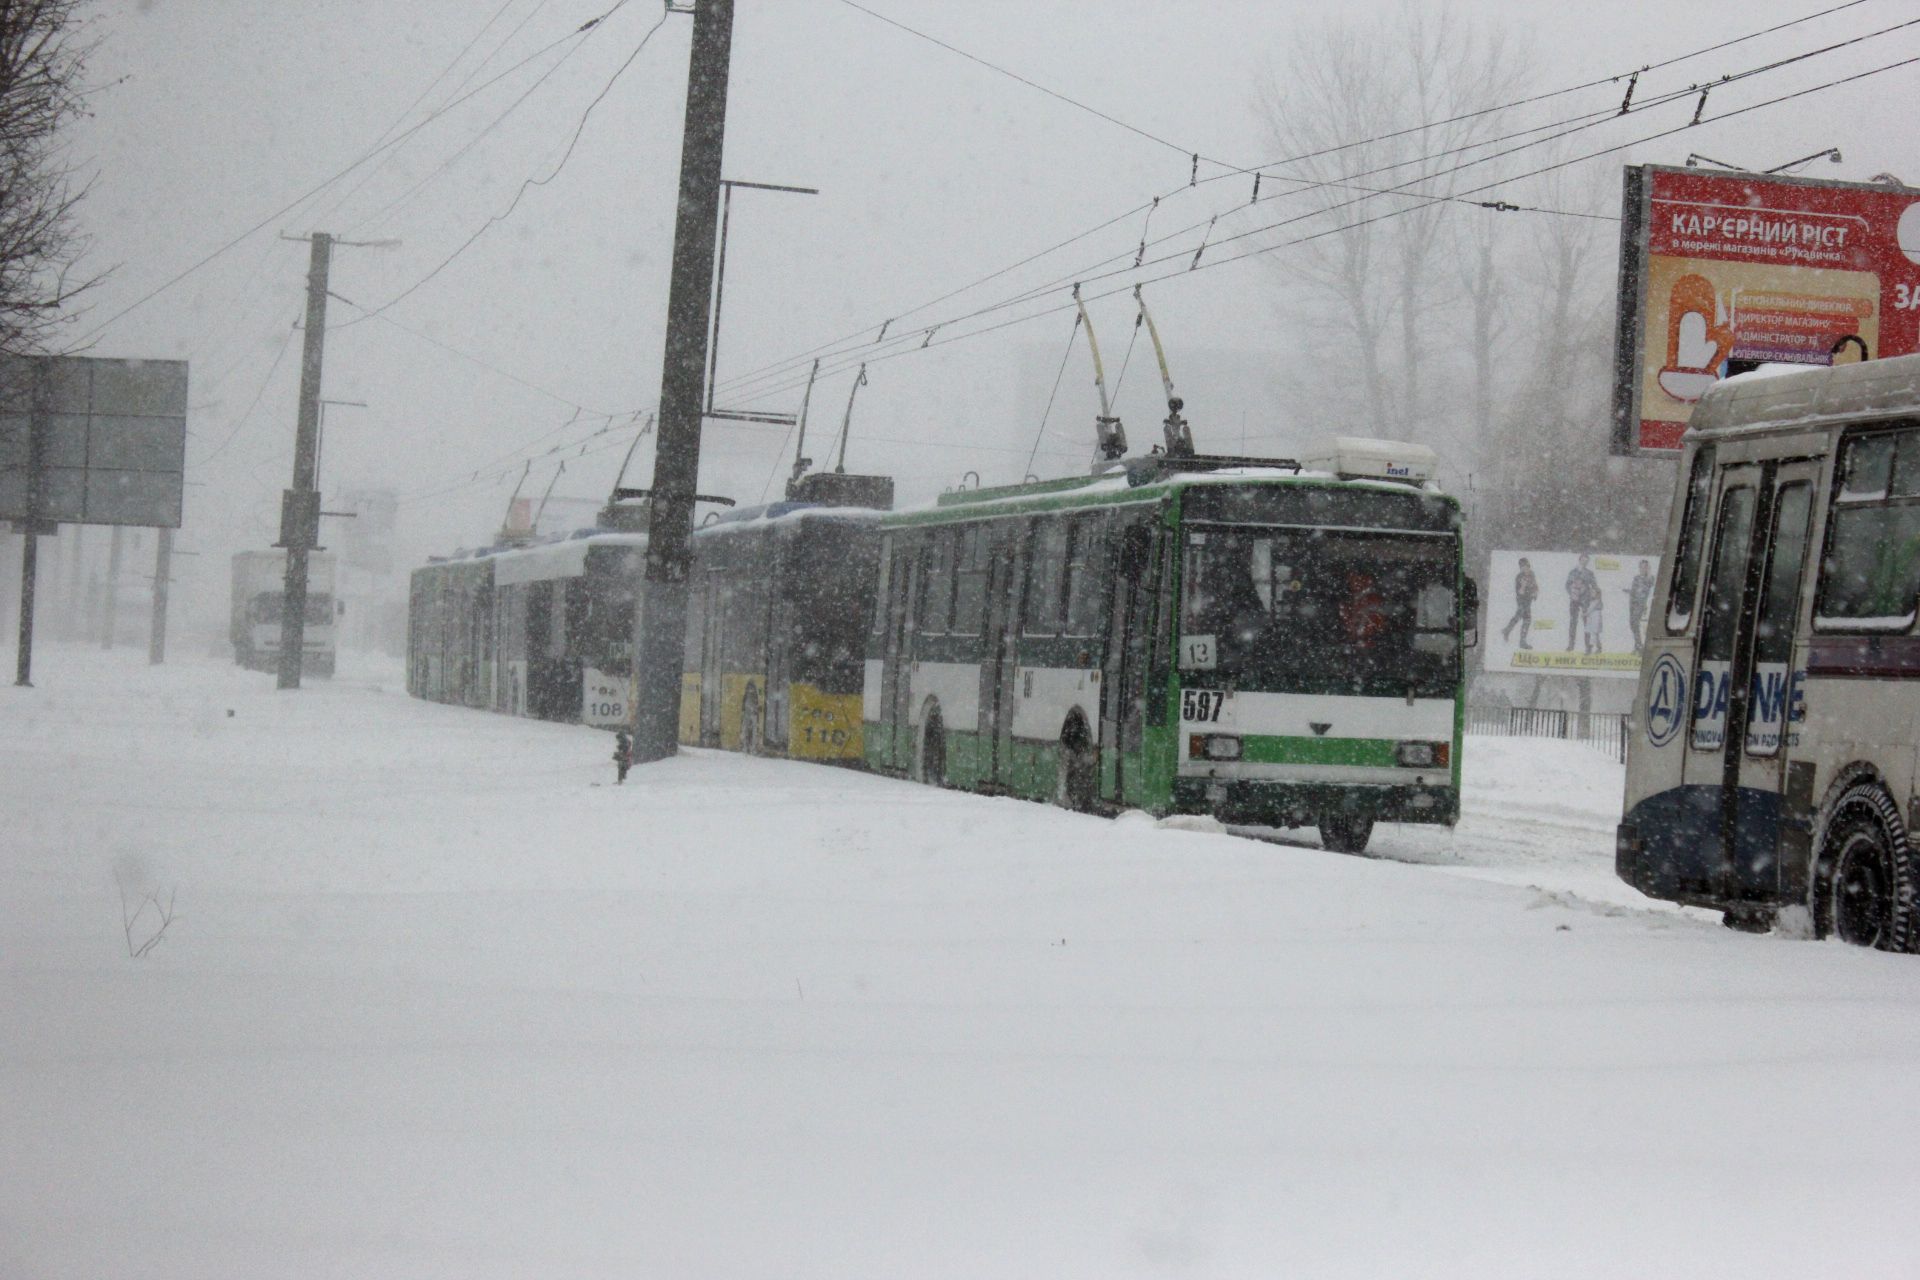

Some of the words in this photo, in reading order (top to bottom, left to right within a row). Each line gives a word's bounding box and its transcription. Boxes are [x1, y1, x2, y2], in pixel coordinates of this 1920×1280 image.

[1802, 224, 1848, 247] РІСТ
[1681, 240, 1720, 252] мережі
[1723, 243, 1777, 256] магазинів
[1738, 313, 1784, 325] ДИРЕКТОР
[1737, 331, 1806, 345] АДМІНІСТРАТОР
[1189, 643, 1209, 664] 13
[1694, 670, 1806, 722] DANKE
[591, 702, 622, 717] 108
[1183, 690, 1225, 722] 597
